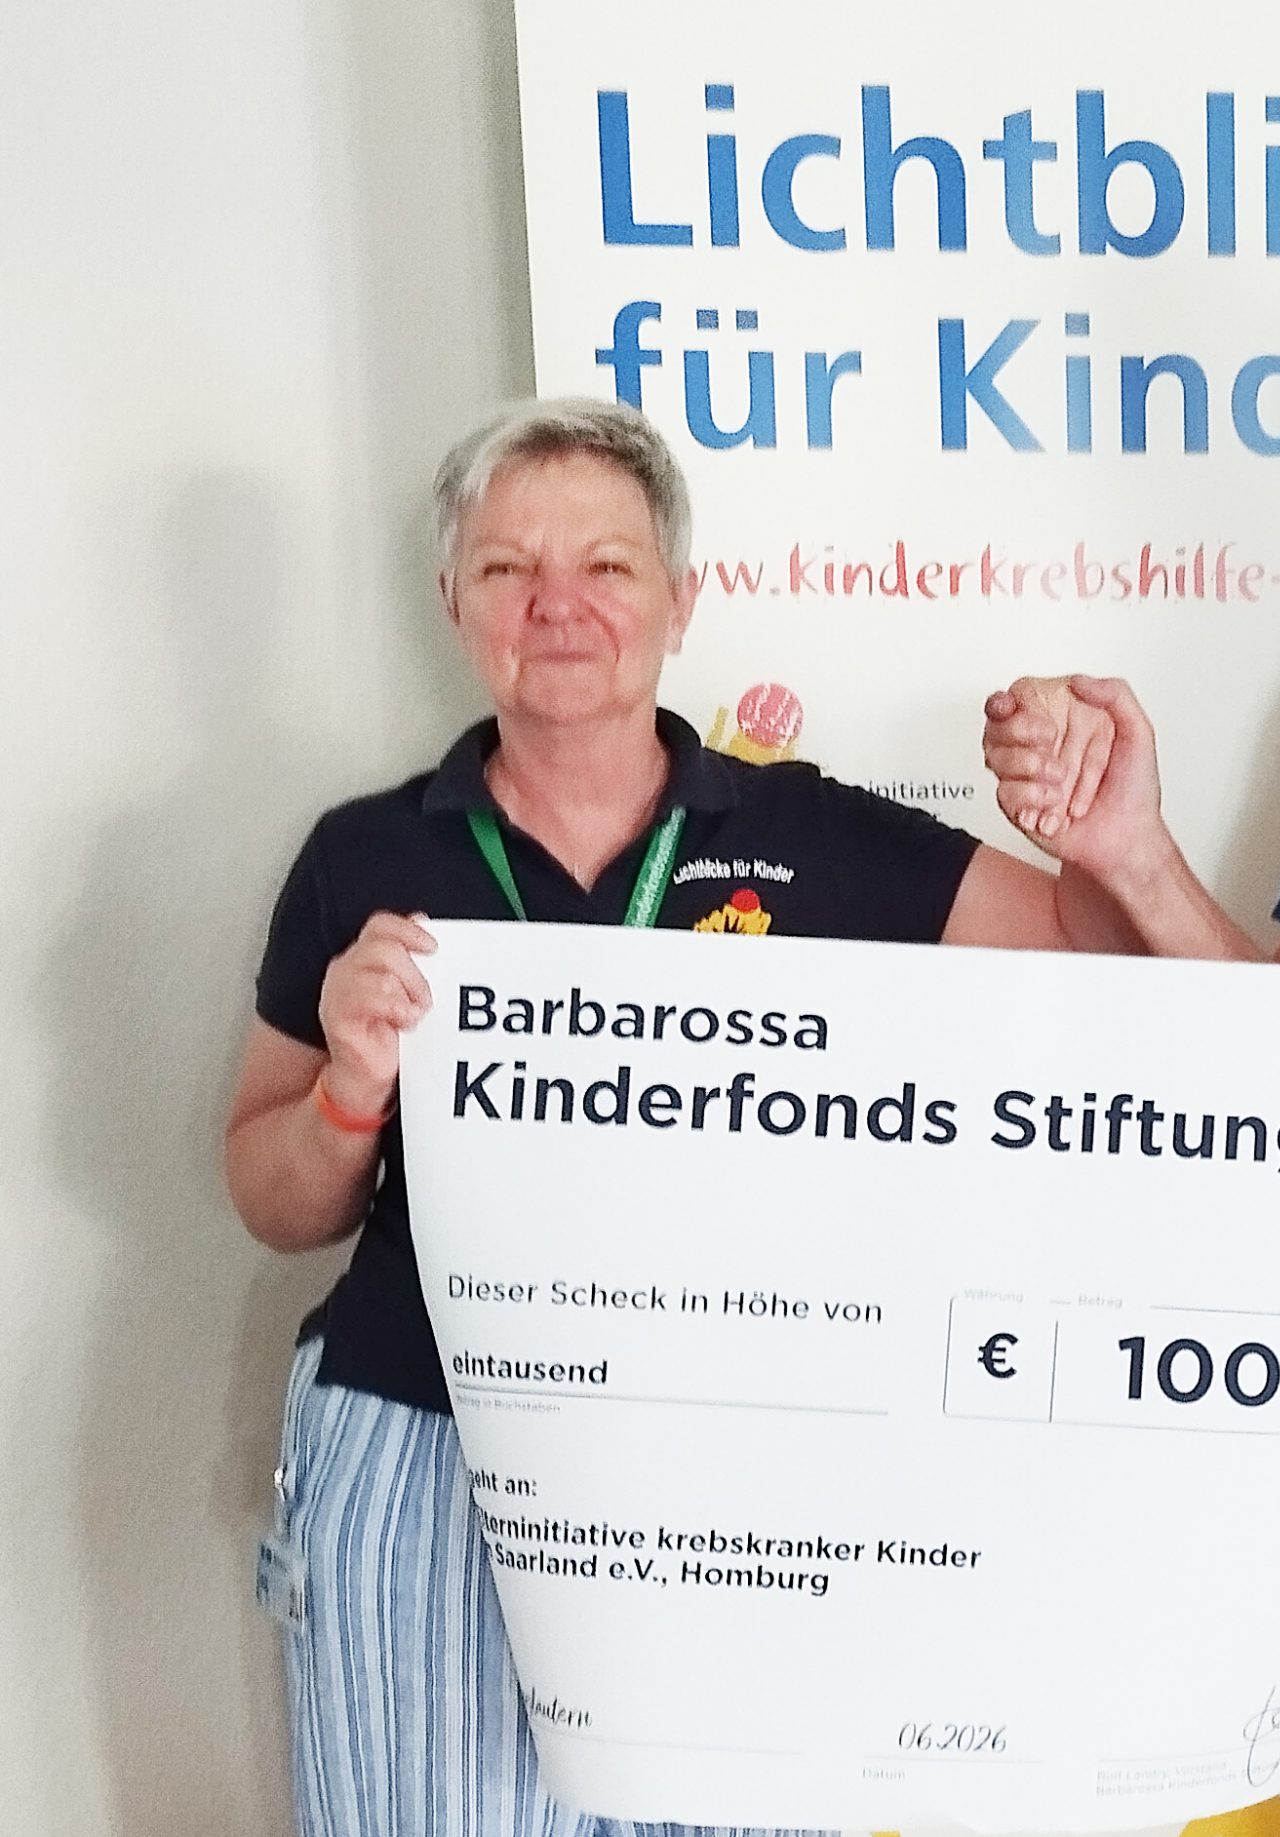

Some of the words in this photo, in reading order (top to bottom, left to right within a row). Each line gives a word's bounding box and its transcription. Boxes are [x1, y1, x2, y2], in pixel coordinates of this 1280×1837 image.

[595, 300, 863, 453] für
[868, 780, 975, 800] initiative
[733, 858, 752, 879] für
[753, 858, 795, 884] Kinder
[457, 983, 829, 1051] Barbarossa
[452, 1059, 958, 1146] Kinderfonds
[448, 1273, 539, 1303] Dieser
[551, 1280, 667, 1310] Scheck
[681, 1286, 709, 1314] in
[722, 1289, 811, 1320] Höhe
[823, 1301, 883, 1324] von
[452, 1348, 609, 1386] eintausend
[976, 1331, 1020, 1380] €
[503, 1475, 537, 1497] an:
[477, 1507, 646, 1550] terninitiative
[656, 1524, 867, 1564] krebskranker
[876, 1538, 984, 1570] Kinder
[495, 1542, 598, 1578] Saarland
[608, 1555, 669, 1587] e.V.,
[679, 1561, 832, 1599] Homburg
